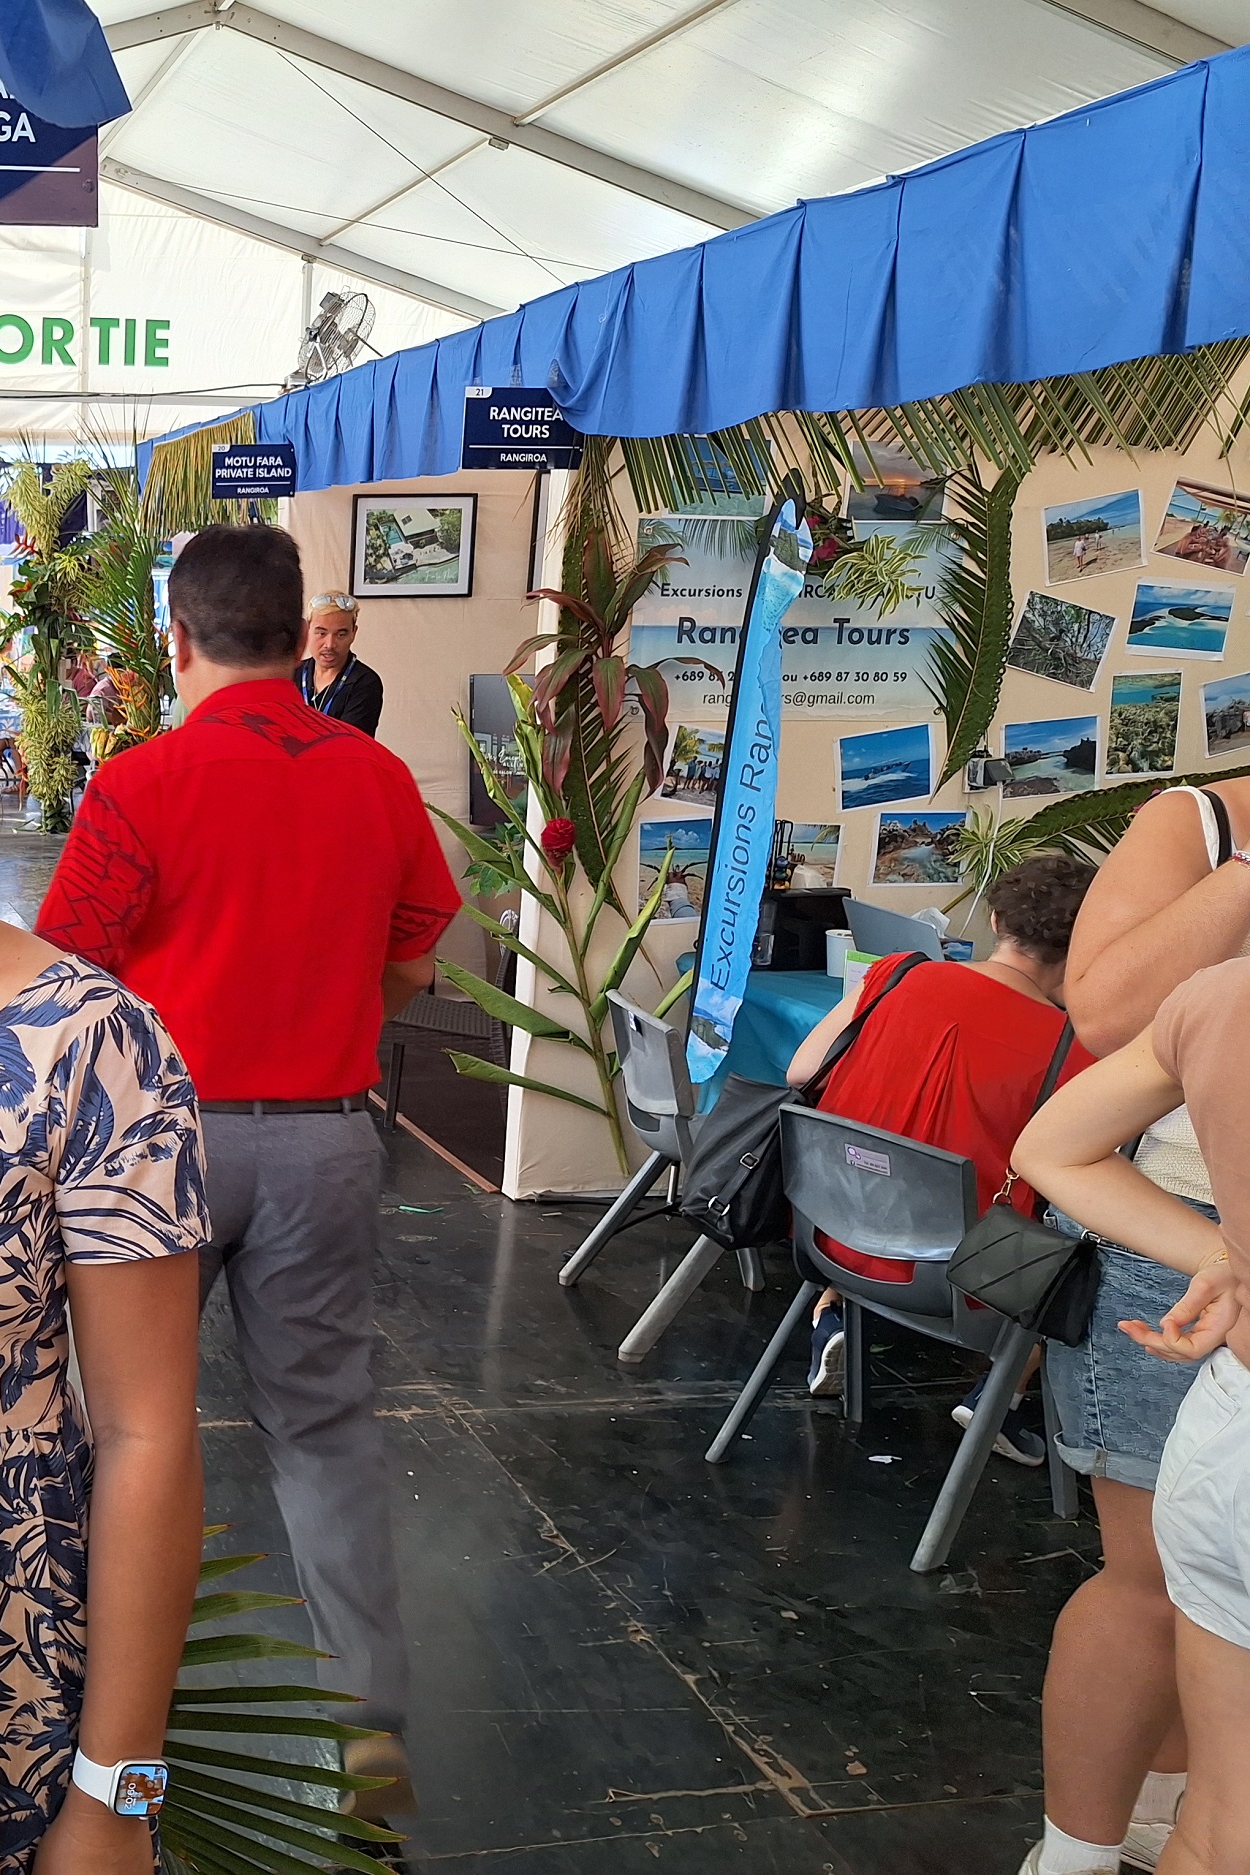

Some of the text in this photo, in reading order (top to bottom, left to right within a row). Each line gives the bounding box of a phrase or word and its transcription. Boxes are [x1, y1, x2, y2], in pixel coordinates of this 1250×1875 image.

[475, 388, 484, 396] 21
[489, 406, 563, 421] RANGITEA
[501, 424, 550, 438] TOURS
[224, 456, 283, 467] MOTU FARA
[500, 453, 547, 462] RANGIROA
[215, 467, 292, 478] PRIVATE ISLAND
[237, 486, 270, 494] RANGIROA
[660, 583, 743, 598] Excursions
[833, 618, 910, 645] Tours
[674, 671, 704, 682] +689
[782, 673, 797, 682] ou
[803, 672, 832, 682] +689
[836, 672, 850, 682] 87
[854, 672, 869, 682] 30
[873, 672, 888, 682] 80
[893, 672, 907, 682] 59
[709, 803, 755, 991] Excursions
